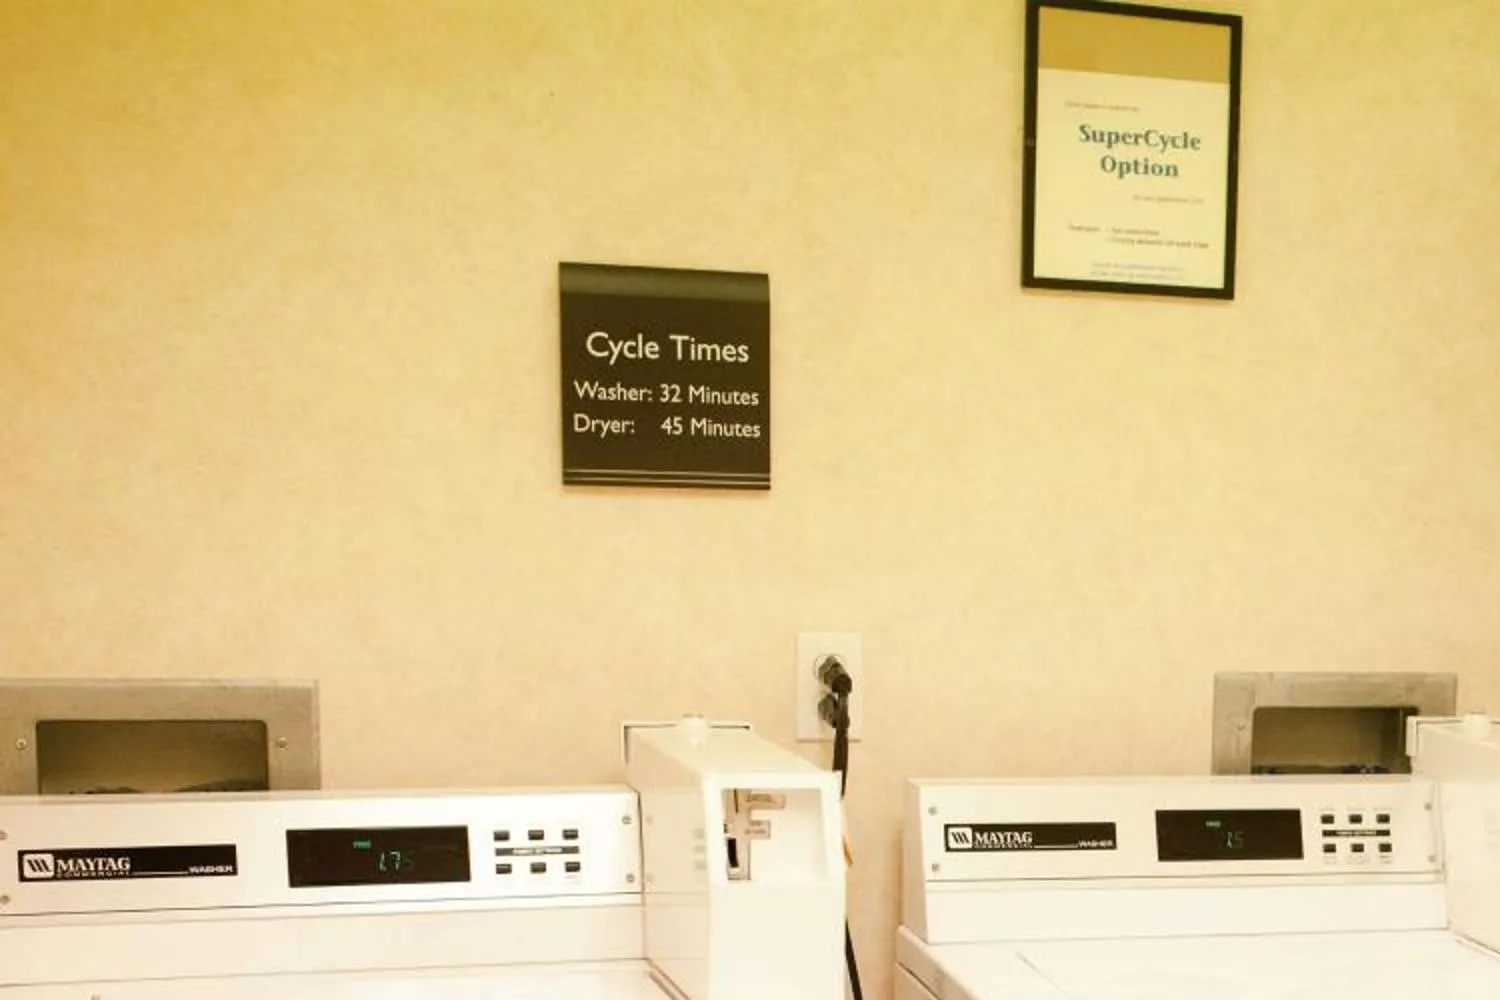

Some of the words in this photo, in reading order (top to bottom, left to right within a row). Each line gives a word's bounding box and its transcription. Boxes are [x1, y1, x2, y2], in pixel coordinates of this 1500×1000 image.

[1078, 123, 1202, 153] SuperCycle
[1100, 155, 1180, 180] Option
[585, 331, 661, 366] Cycle
[669, 334, 750, 363] Times
[573, 379, 653, 402] Washer:
[659, 383, 683, 404] 32
[688, 384, 760, 407] Minutes
[573, 413, 636, 439] Dryer:
[660, 416, 684, 436] 45
[690, 417, 761, 438] Minutes
[974, 831, 1033, 844] MAYTAG
[56, 857, 131, 873] MAYTAG
